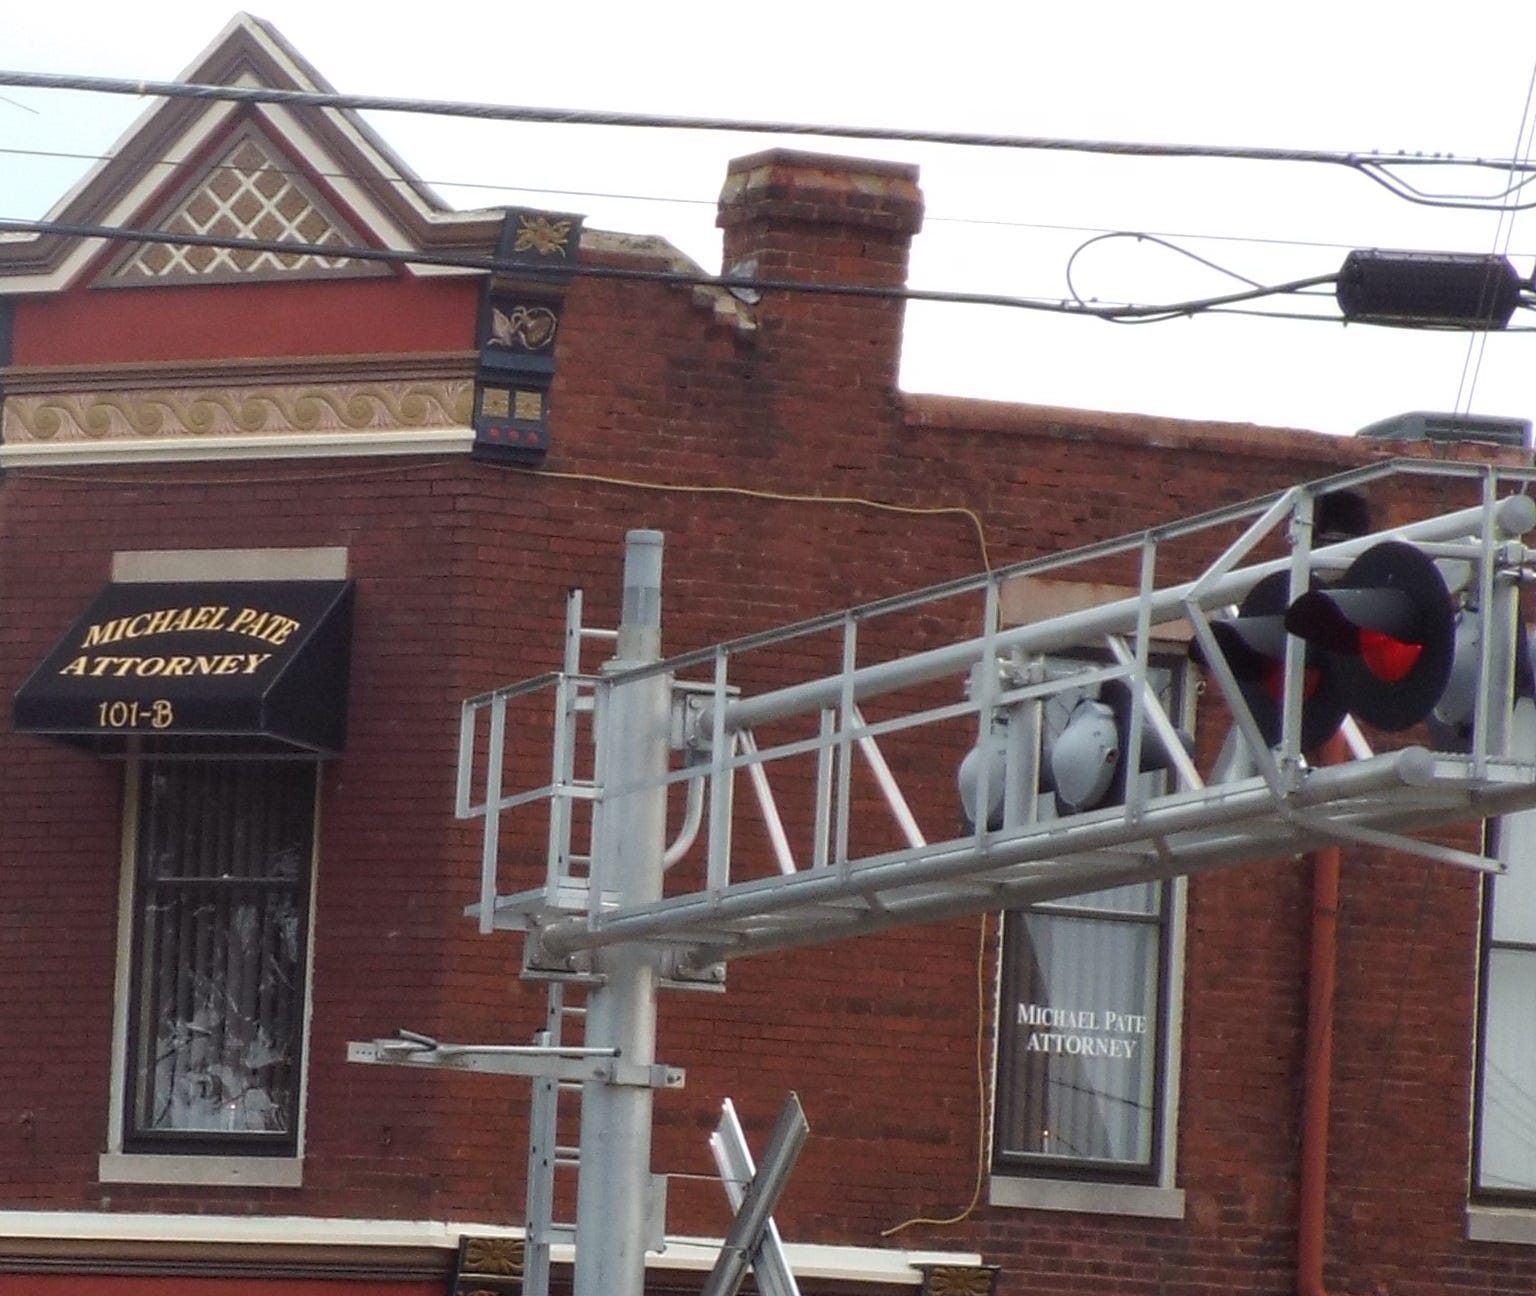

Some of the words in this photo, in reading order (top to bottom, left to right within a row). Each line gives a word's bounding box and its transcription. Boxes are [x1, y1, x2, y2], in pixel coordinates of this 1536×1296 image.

[81, 606, 230, 649] MICHAEL
[227, 607, 302, 646] PATE
[59, 654, 271, 677] ATTORNEY
[99, 699, 174, 728] 101-B
[1027, 1032, 1137, 1059] ATTORNEY
